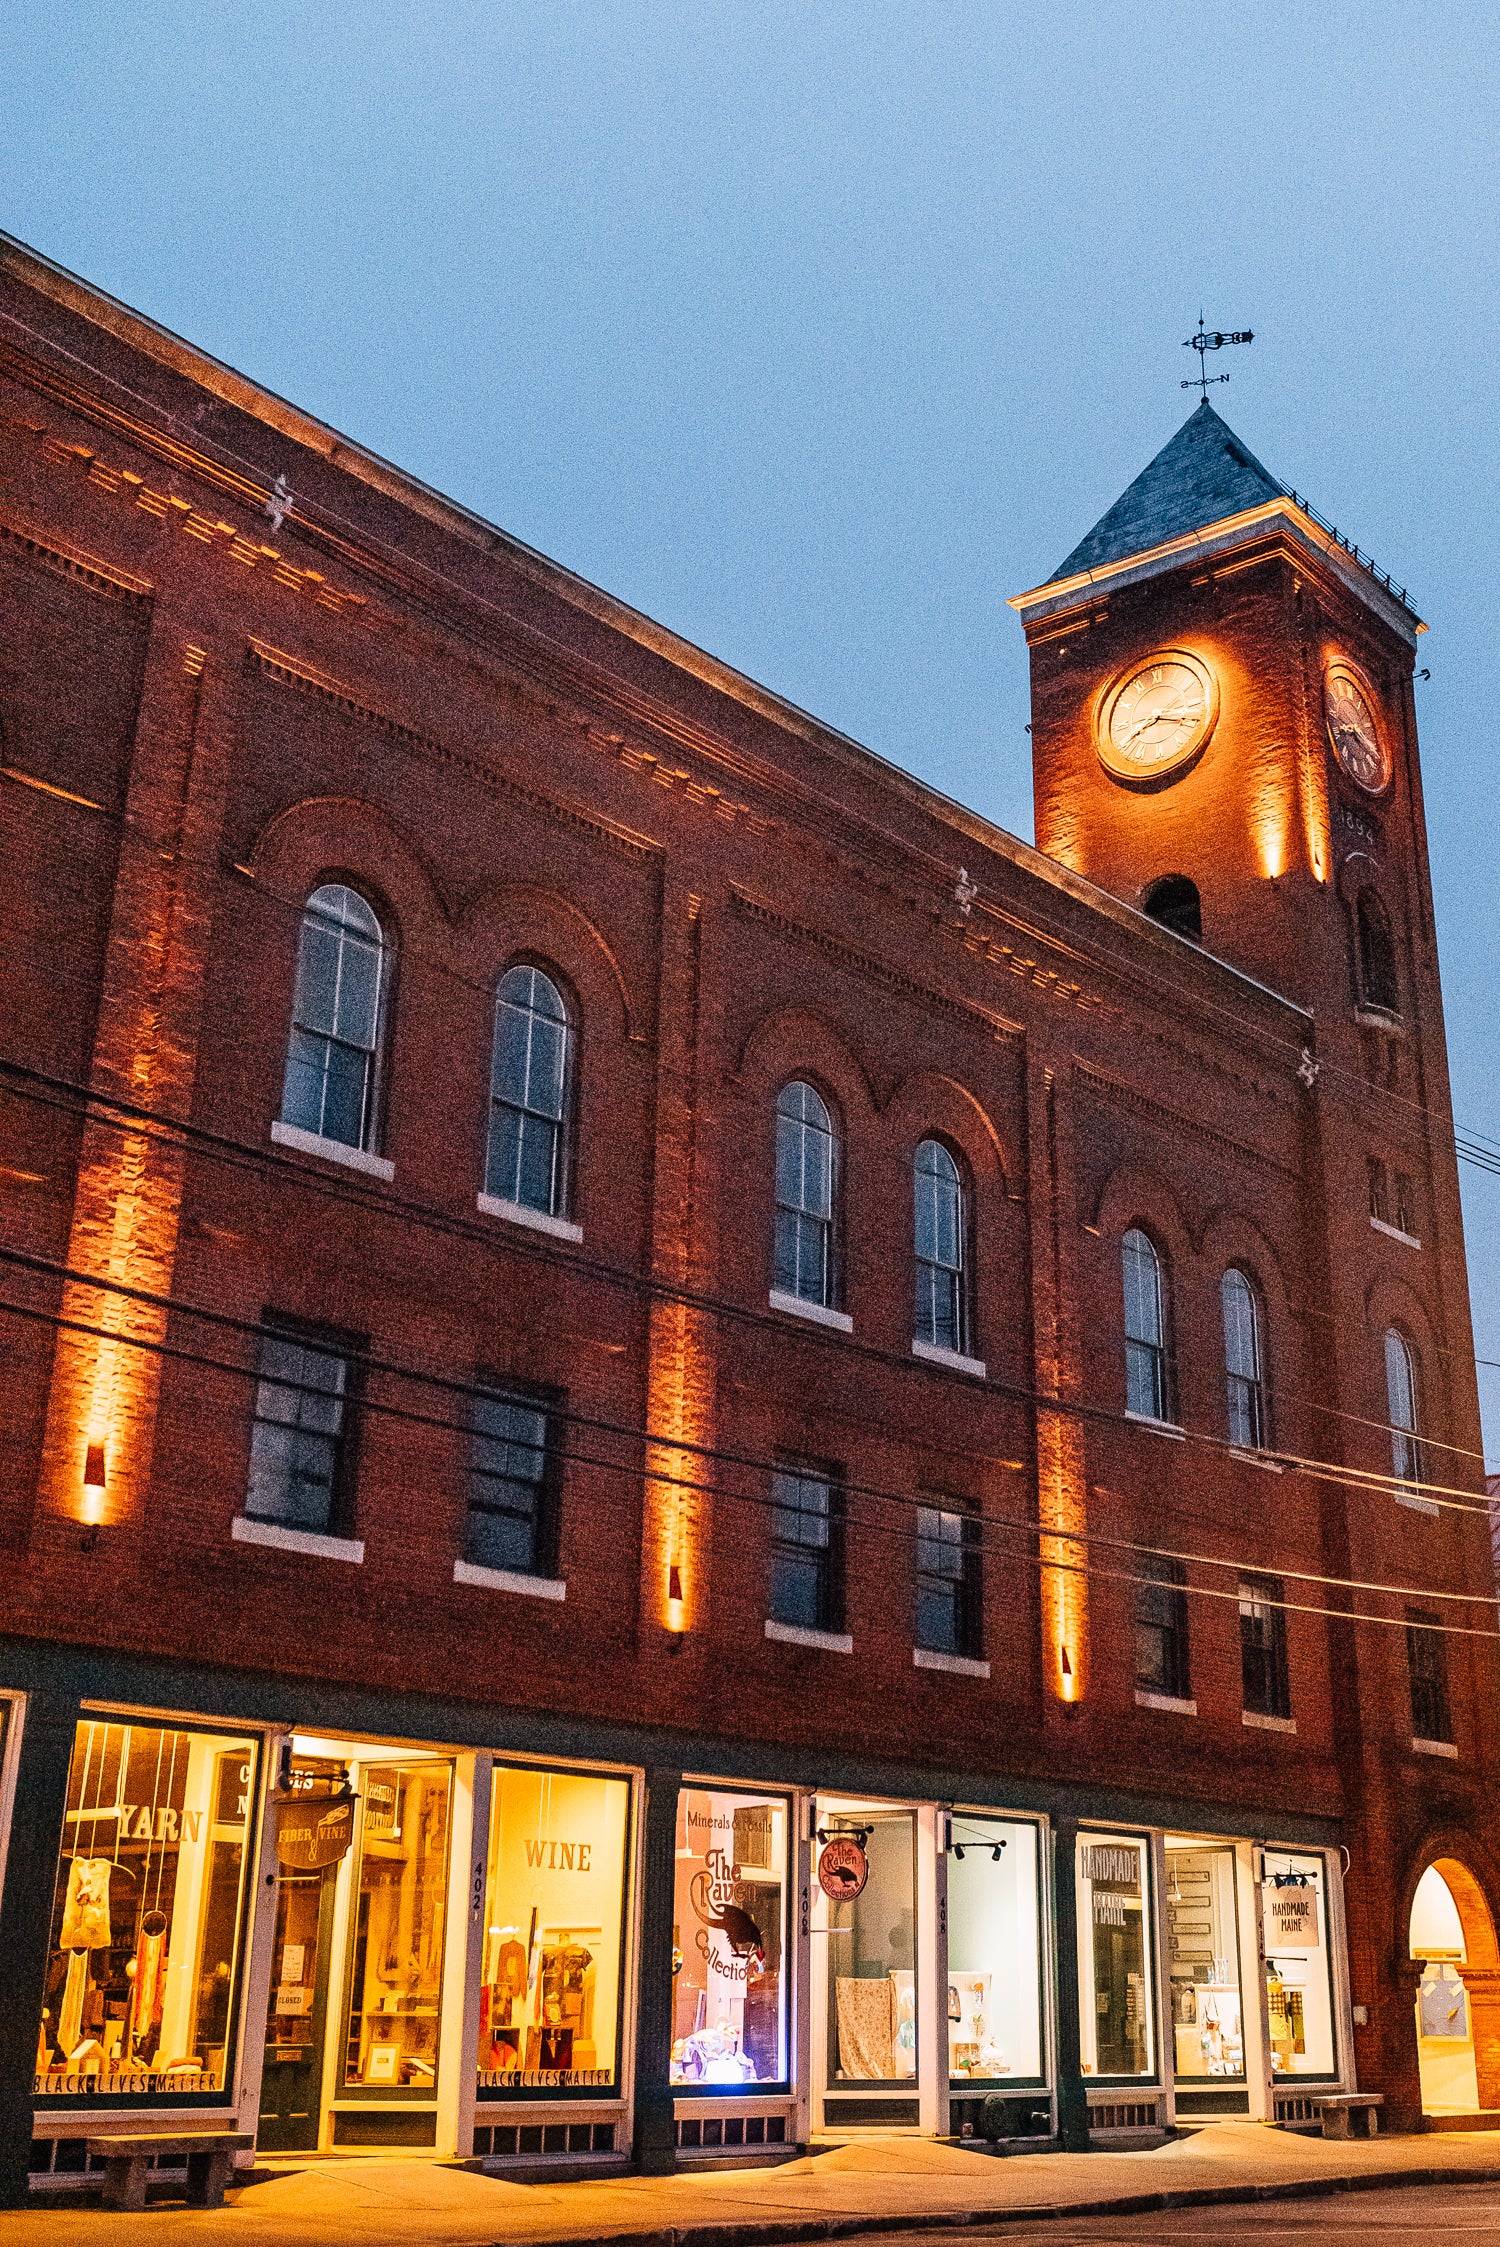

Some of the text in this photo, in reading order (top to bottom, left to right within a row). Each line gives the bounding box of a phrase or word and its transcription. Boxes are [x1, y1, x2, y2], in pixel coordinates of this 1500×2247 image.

[118, 1804, 203, 1843] YARN
[688, 1810, 730, 1830] Minerals
[279, 1825, 346, 1842] FIBER VINE
[523, 1839, 591, 1872] WINE
[833, 1845, 853, 1857] The
[705, 1849, 741, 1883] The
[823, 1854, 857, 1869] Raven
[1081, 1845, 1138, 1883] HANDMADE
[473, 1862, 482, 1909] 402
[690, 1871, 757, 1908] Raven
[1094, 1891, 1126, 1926] MAINE
[1272, 1902, 1310, 1916] HANDMADE
[1281, 1918, 1302, 1931] MAINE
[279, 1996, 302, 2004] CLOSED
[33, 2073, 216, 2093] BLACK LIVES MATTER
[476, 2069, 610, 2087] BLACK LIVES MATTER
